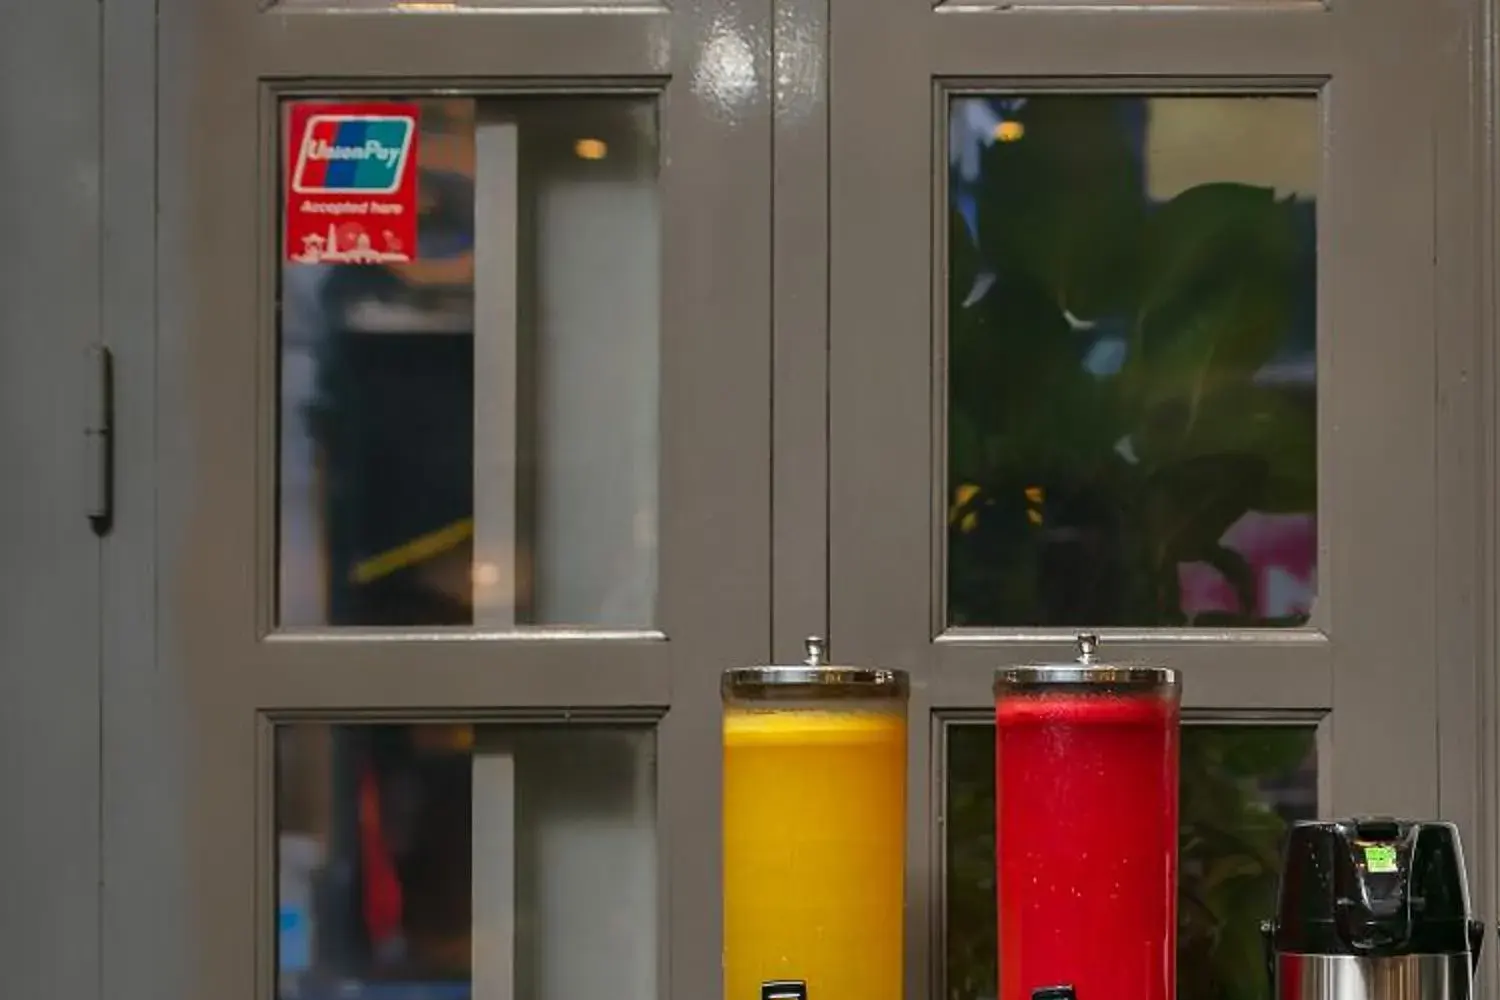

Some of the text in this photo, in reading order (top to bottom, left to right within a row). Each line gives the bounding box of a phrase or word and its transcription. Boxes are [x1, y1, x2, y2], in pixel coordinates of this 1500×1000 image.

[307, 139, 400, 169] UnionPay
[299, 200, 404, 215] Accepted here
